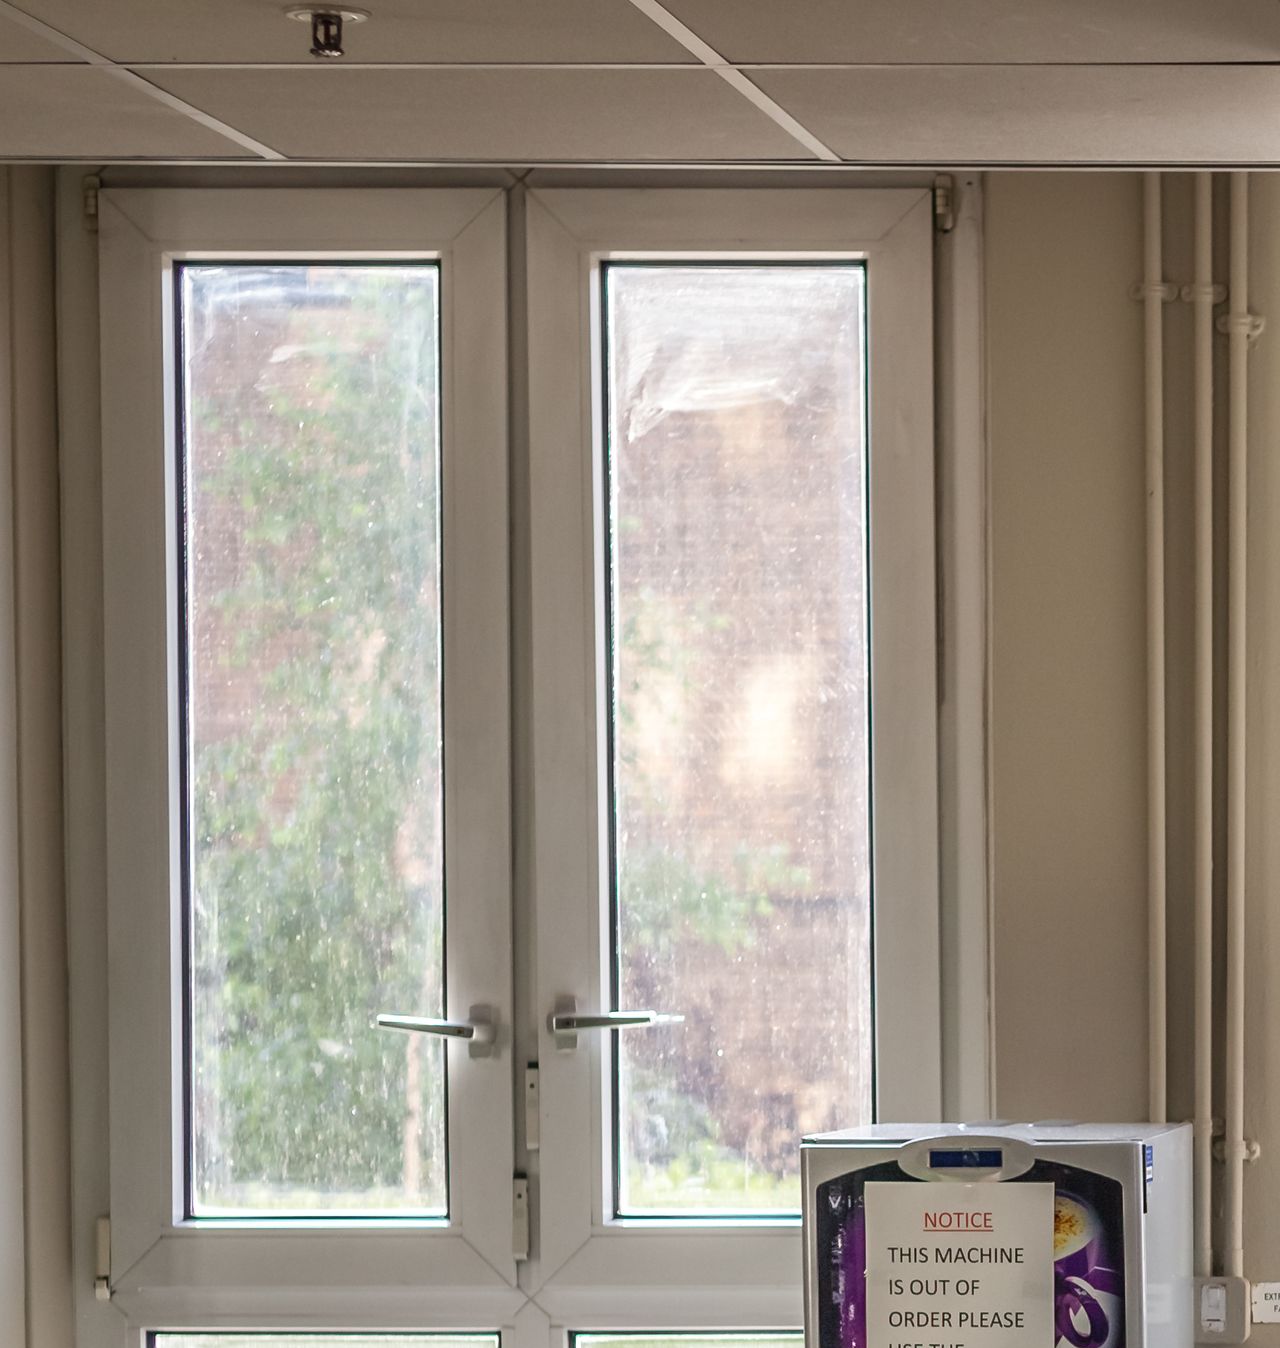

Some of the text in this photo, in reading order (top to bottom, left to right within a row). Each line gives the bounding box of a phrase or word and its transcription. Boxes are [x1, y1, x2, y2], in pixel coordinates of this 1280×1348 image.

[923, 1212, 994, 1230] NOTICE
[887, 1247, 1024, 1264] THIS MACHINE
[889, 1279, 980, 1296] IS OUT OF
[888, 1311, 1025, 1328] ORDER PLEASE
